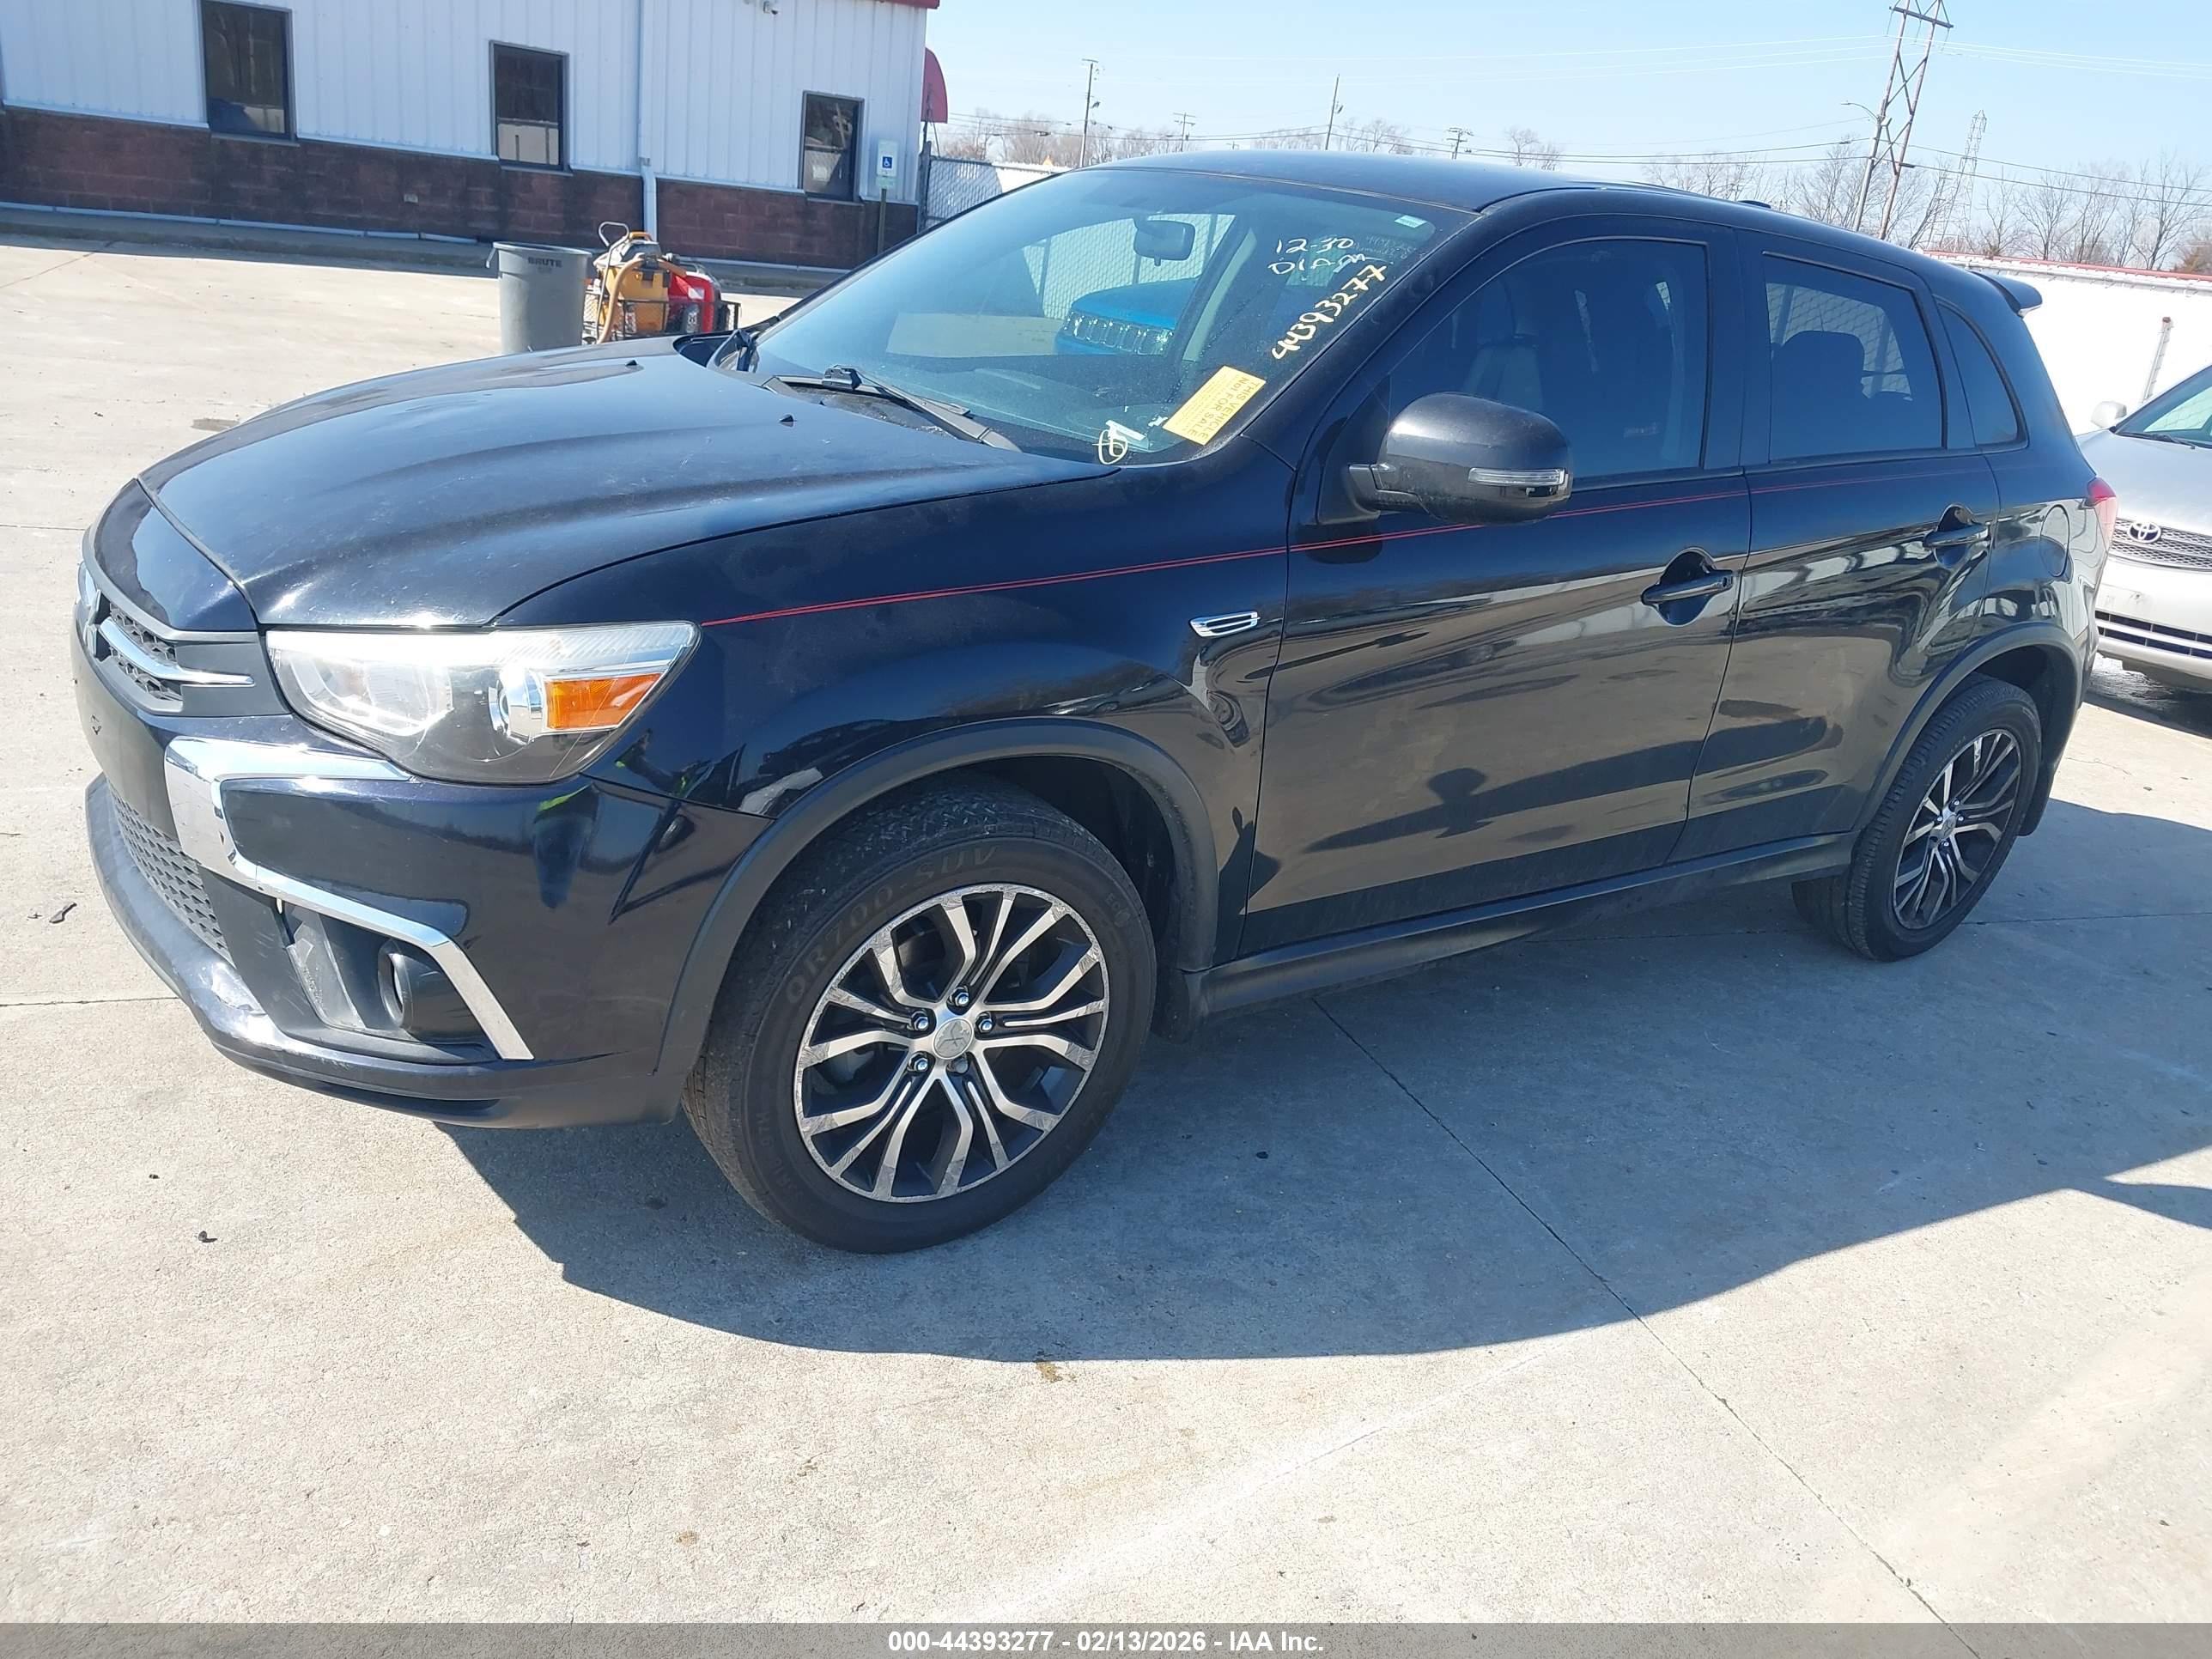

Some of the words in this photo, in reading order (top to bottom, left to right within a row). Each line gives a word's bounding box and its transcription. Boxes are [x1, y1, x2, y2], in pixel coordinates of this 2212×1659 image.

[527, 257, 562, 268] BRUTE
[1272, 264, 1387, 359] 44393277
[1212, 392, 1235, 412] FOR
[1235, 381, 1261, 401] THIS
[1187, 411, 1215, 438] SALE
[1197, 402, 1240, 439] VEHICLE
